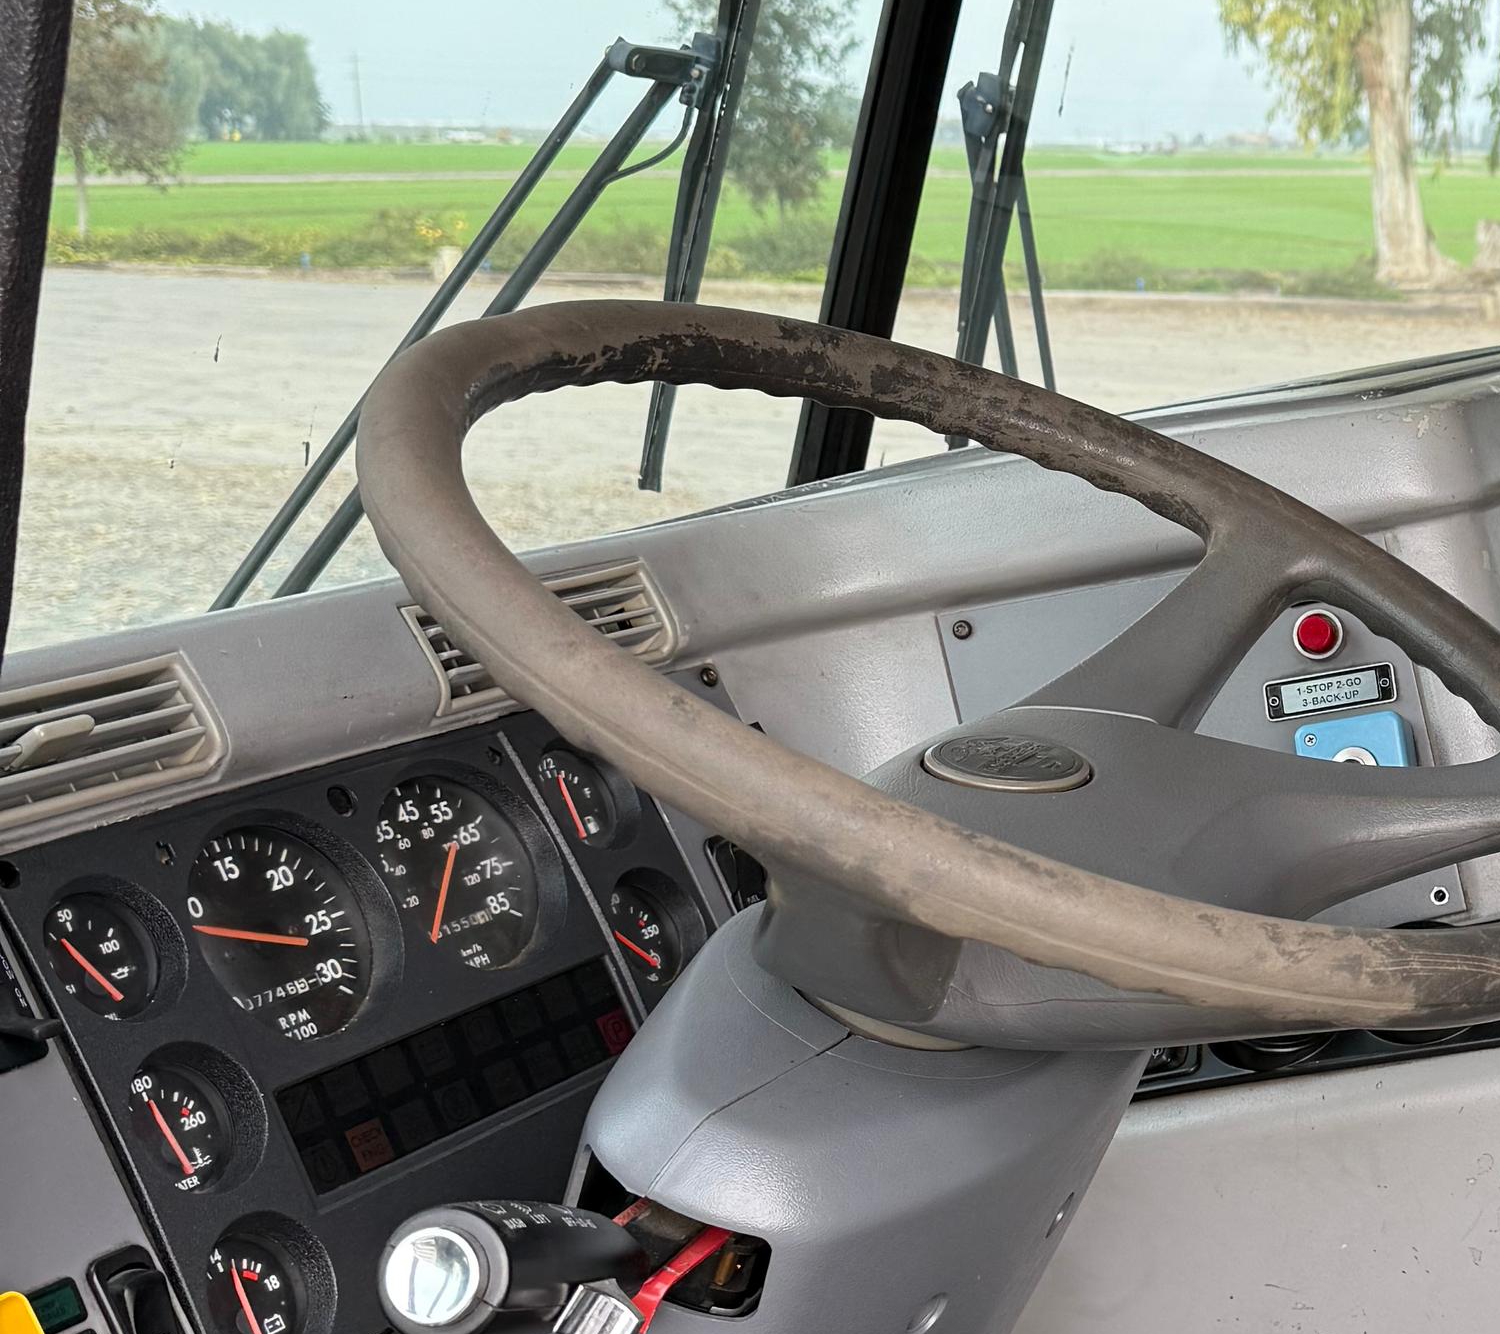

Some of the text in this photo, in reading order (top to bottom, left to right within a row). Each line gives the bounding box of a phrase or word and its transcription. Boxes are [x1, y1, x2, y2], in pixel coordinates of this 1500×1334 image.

[1296, 676, 1362, 697] 1-STOP 2-GO
[1302, 689, 1360, 708] 3-BACK-UP
[397, 799, 420, 823] 45
[429, 800, 453, 824] 55
[421, 826, 436, 840] 80
[459, 822, 481, 846] 65
[398, 837, 412, 851] 60
[213, 855, 240, 882] 15
[479, 856, 503, 879] 75
[265, 864, 295, 892] 20
[463, 872, 482, 888] 120
[406, 894, 420, 908] 20
[485, 891, 511, 915] 85
[56, 908, 74, 923] 50
[304, 909, 333, 936] 25
[641, 924, 660, 940] 350
[99, 939, 121, 955] 100
[460, 943, 484, 957] km/h
[315, 958, 343, 984] 30
[278, 1008, 312, 1030] RPM
[130, 1075, 153, 1095] 180
[180, 1110, 207, 1132] 260
[209, 1247, 222, 1265] 14
[263, 1274, 280, 1292] 18
